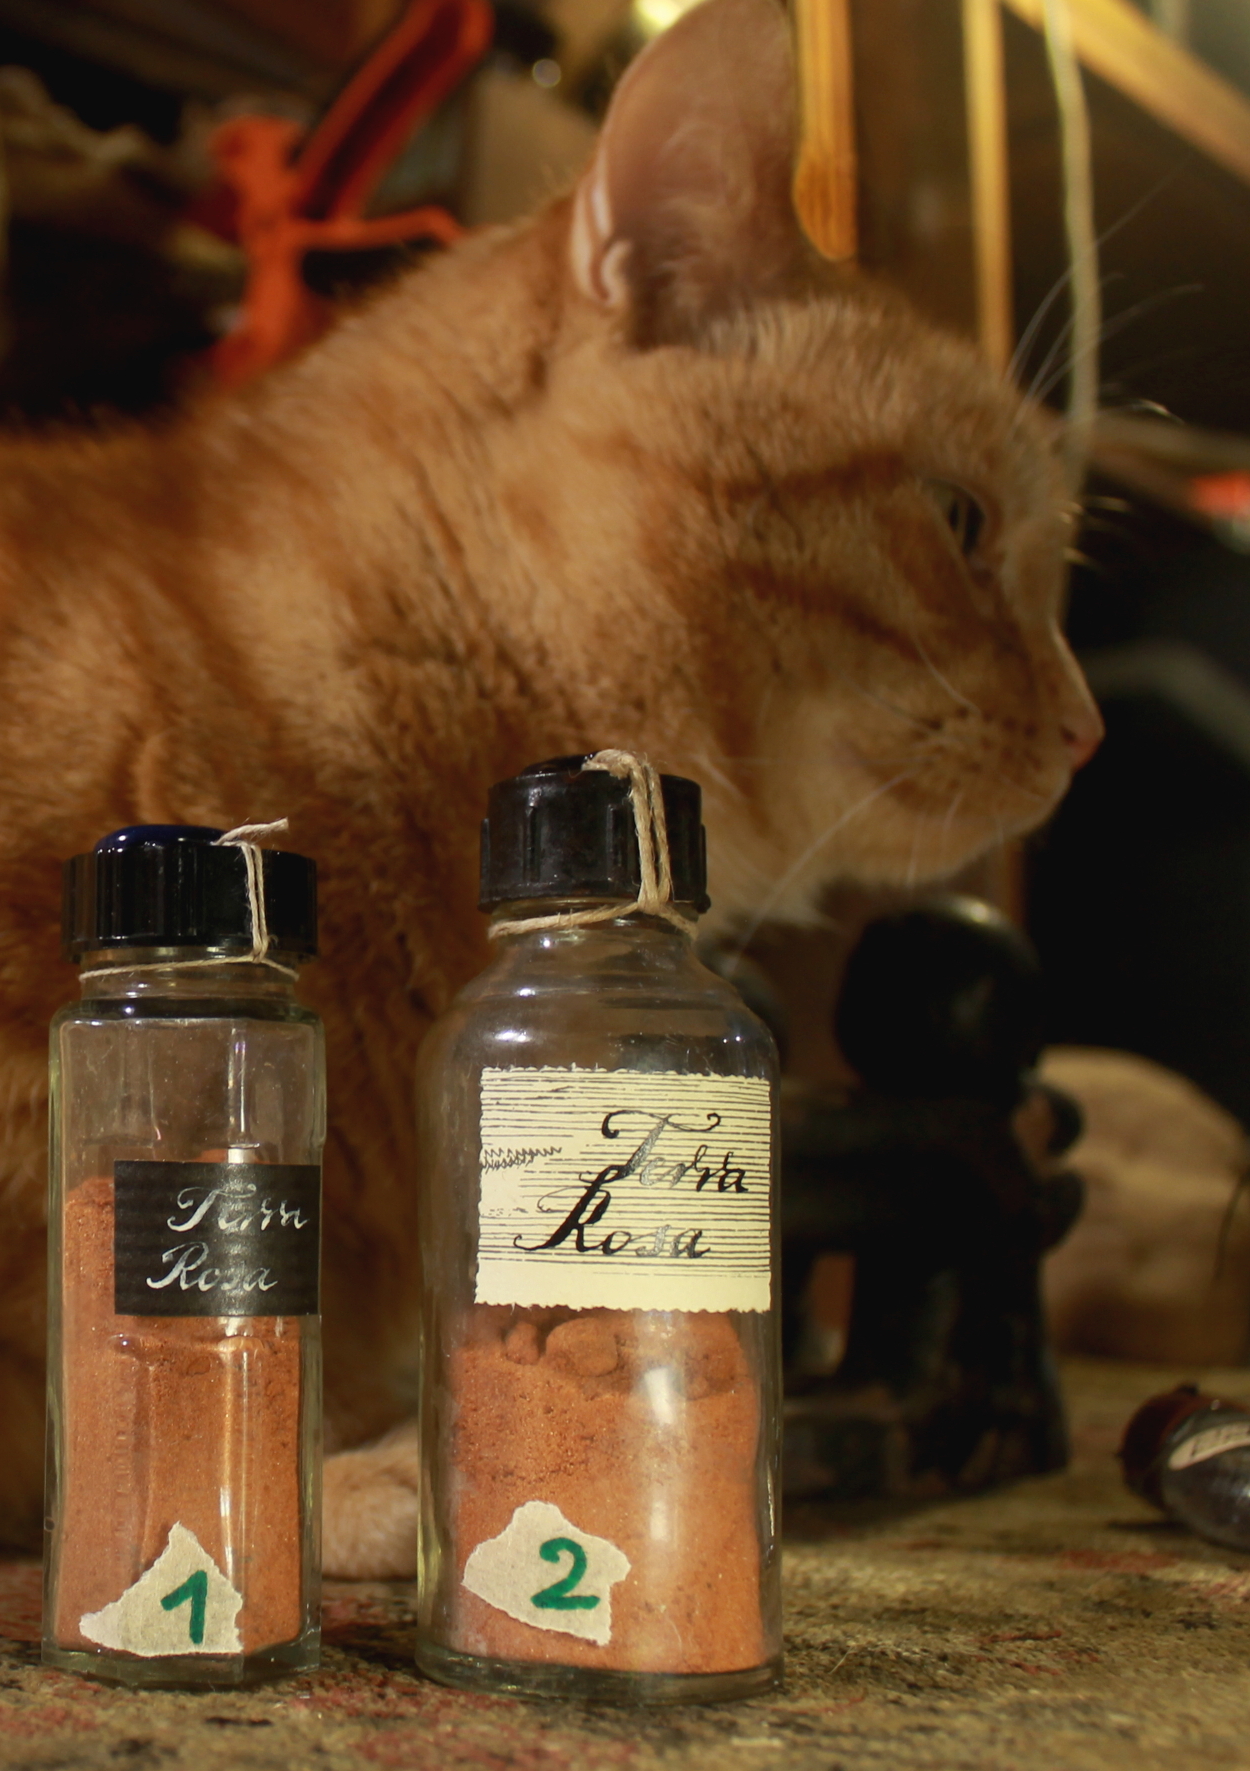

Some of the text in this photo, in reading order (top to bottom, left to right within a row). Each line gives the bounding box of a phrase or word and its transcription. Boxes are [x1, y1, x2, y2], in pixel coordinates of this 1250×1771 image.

[512, 1180, 711, 1259] Rosa
[145, 1241, 279, 1292] Rosa
[160, 1569, 209, 1645] 1
[529, 1536, 601, 1611] 2
